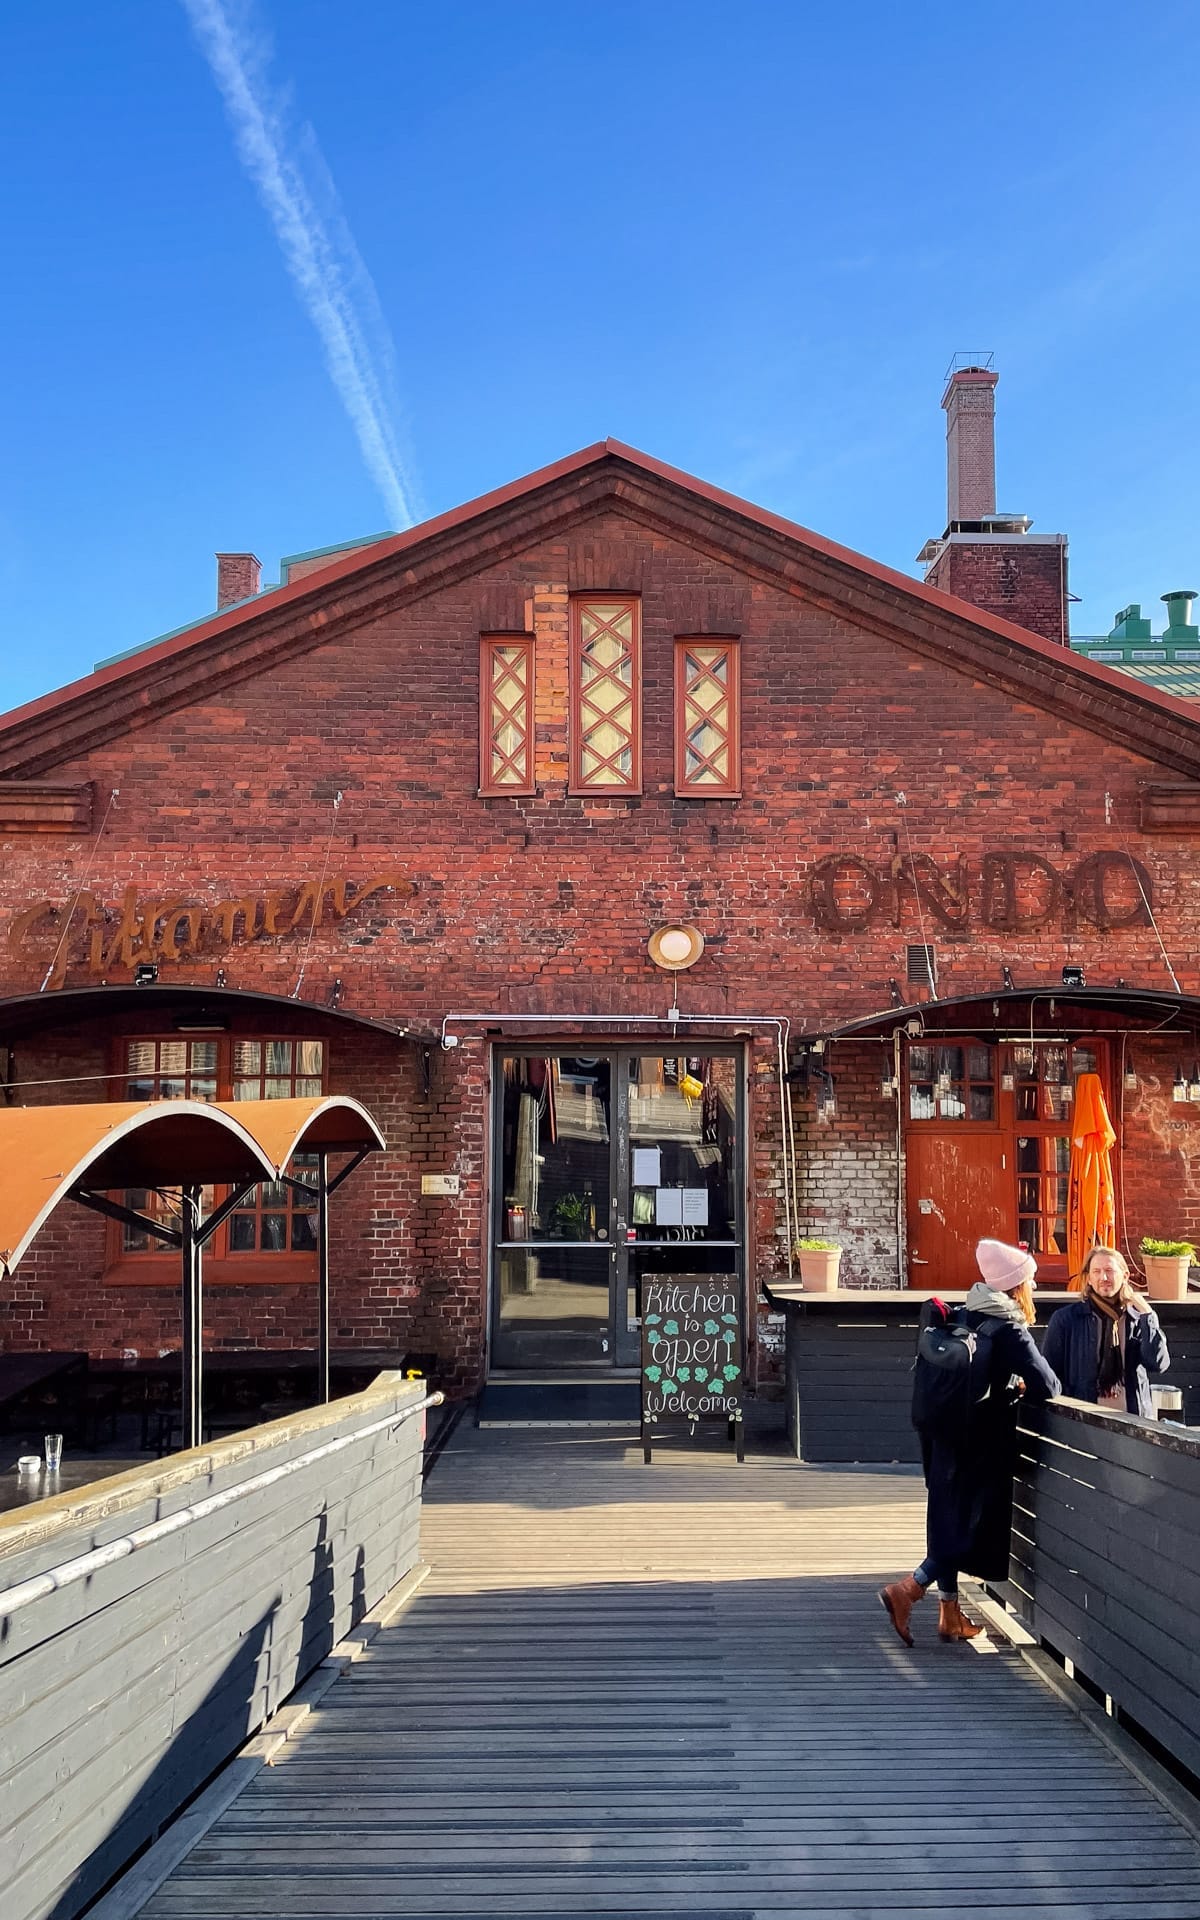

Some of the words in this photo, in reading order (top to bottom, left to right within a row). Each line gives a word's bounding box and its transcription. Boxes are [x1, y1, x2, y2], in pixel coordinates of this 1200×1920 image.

[644, 1285, 737, 1313] Kitchen
[684, 1313, 703, 1332] is
[652, 1339, 733, 1378] open
[645, 1390, 738, 1413] Welcome
